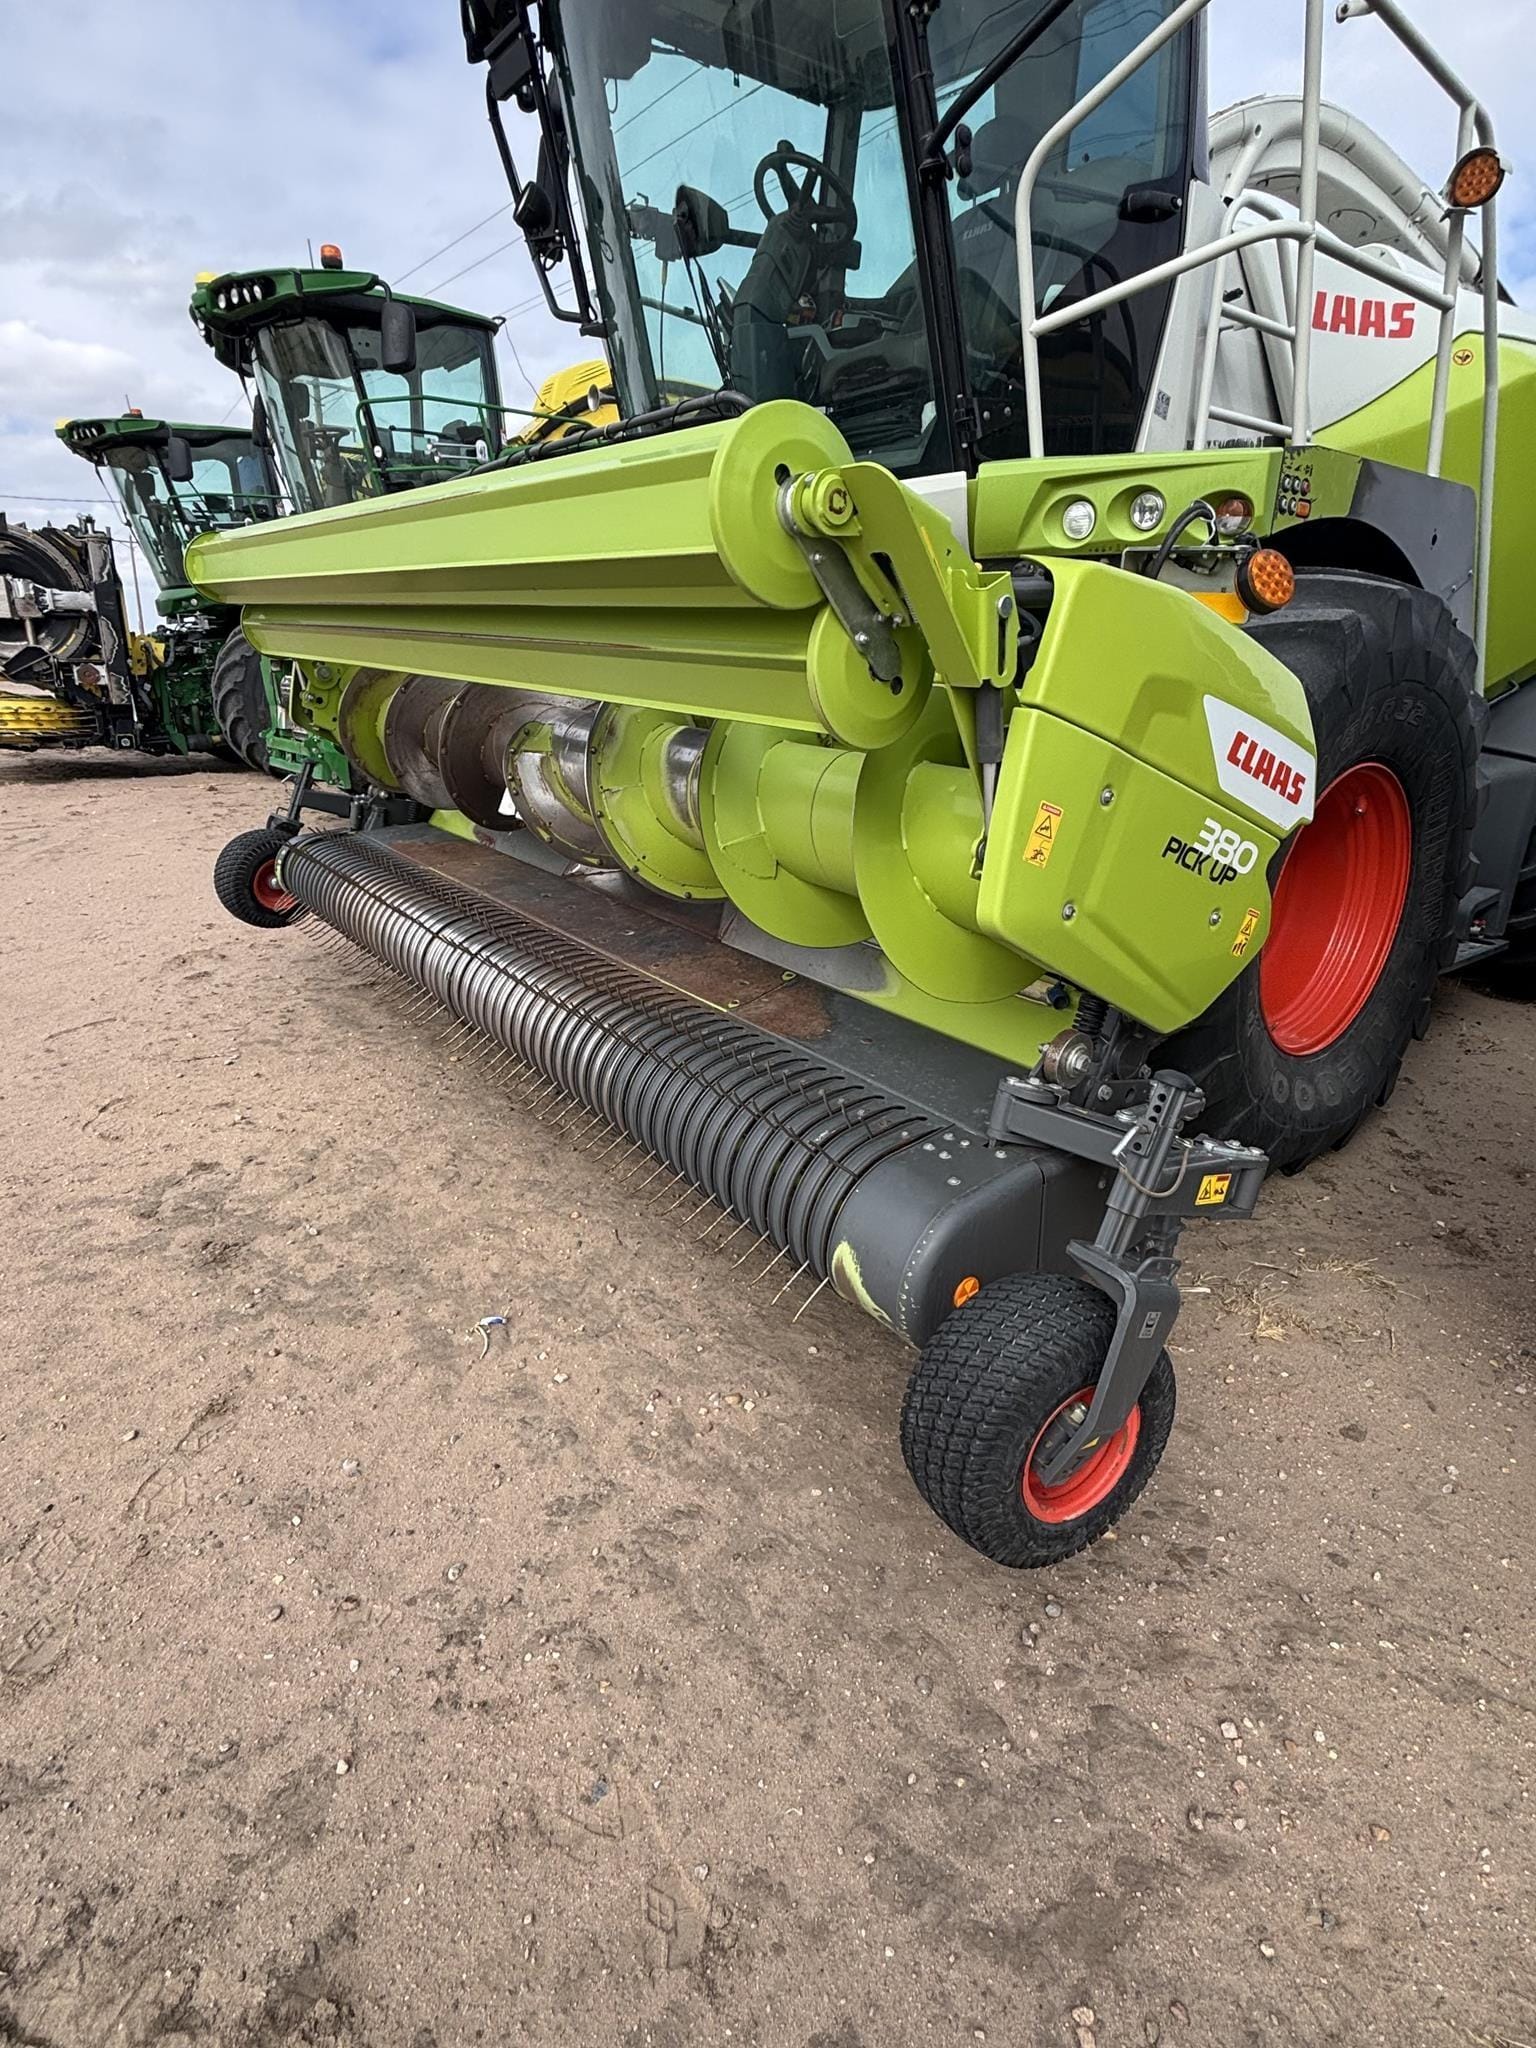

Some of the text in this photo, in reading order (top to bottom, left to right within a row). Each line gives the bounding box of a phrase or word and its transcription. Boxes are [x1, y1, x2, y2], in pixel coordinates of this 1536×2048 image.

[1311, 291, 1415, 339] LAAS
[1226, 730, 1306, 806] CLAAS
[1161, 836, 1238, 885] PICK UP
[1192, 817, 1259, 875] 380
